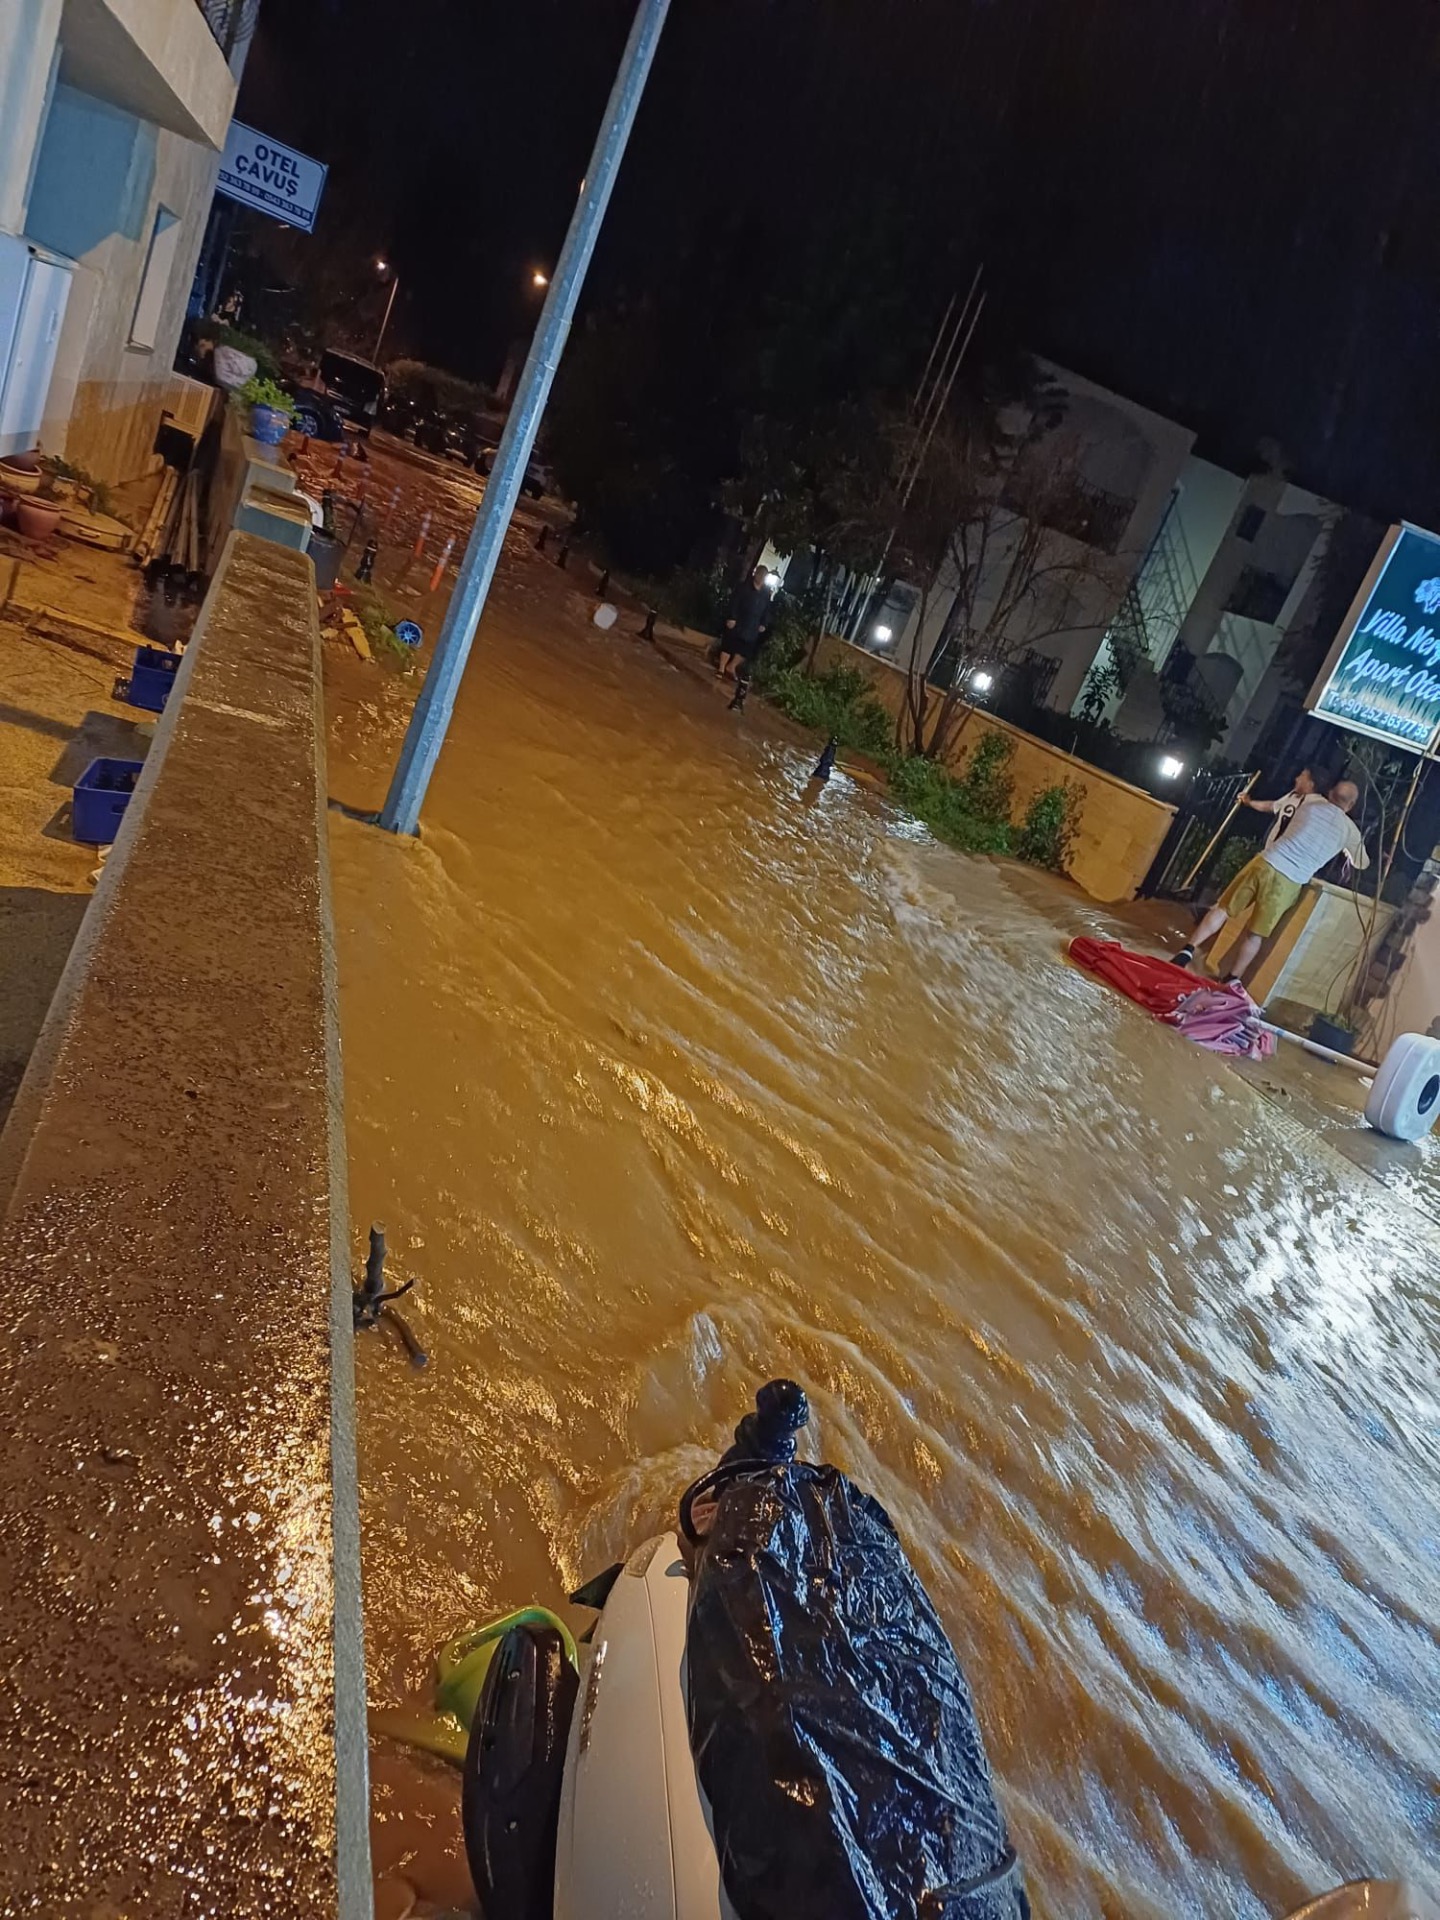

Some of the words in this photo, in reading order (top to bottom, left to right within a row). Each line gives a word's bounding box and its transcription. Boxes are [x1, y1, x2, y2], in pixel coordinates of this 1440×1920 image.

[235, 155, 299, 197] ÇAVUŞ
[254, 144, 300, 179] OTEL
[1358, 608, 1407, 645] Villa
[1344, 648, 1413, 687] Apart
[1360, 706, 1382, 722] 252
[1381, 713, 1402, 729] 363
[1400, 718, 1417, 734] 77
[1414, 723, 1432, 738] 35
